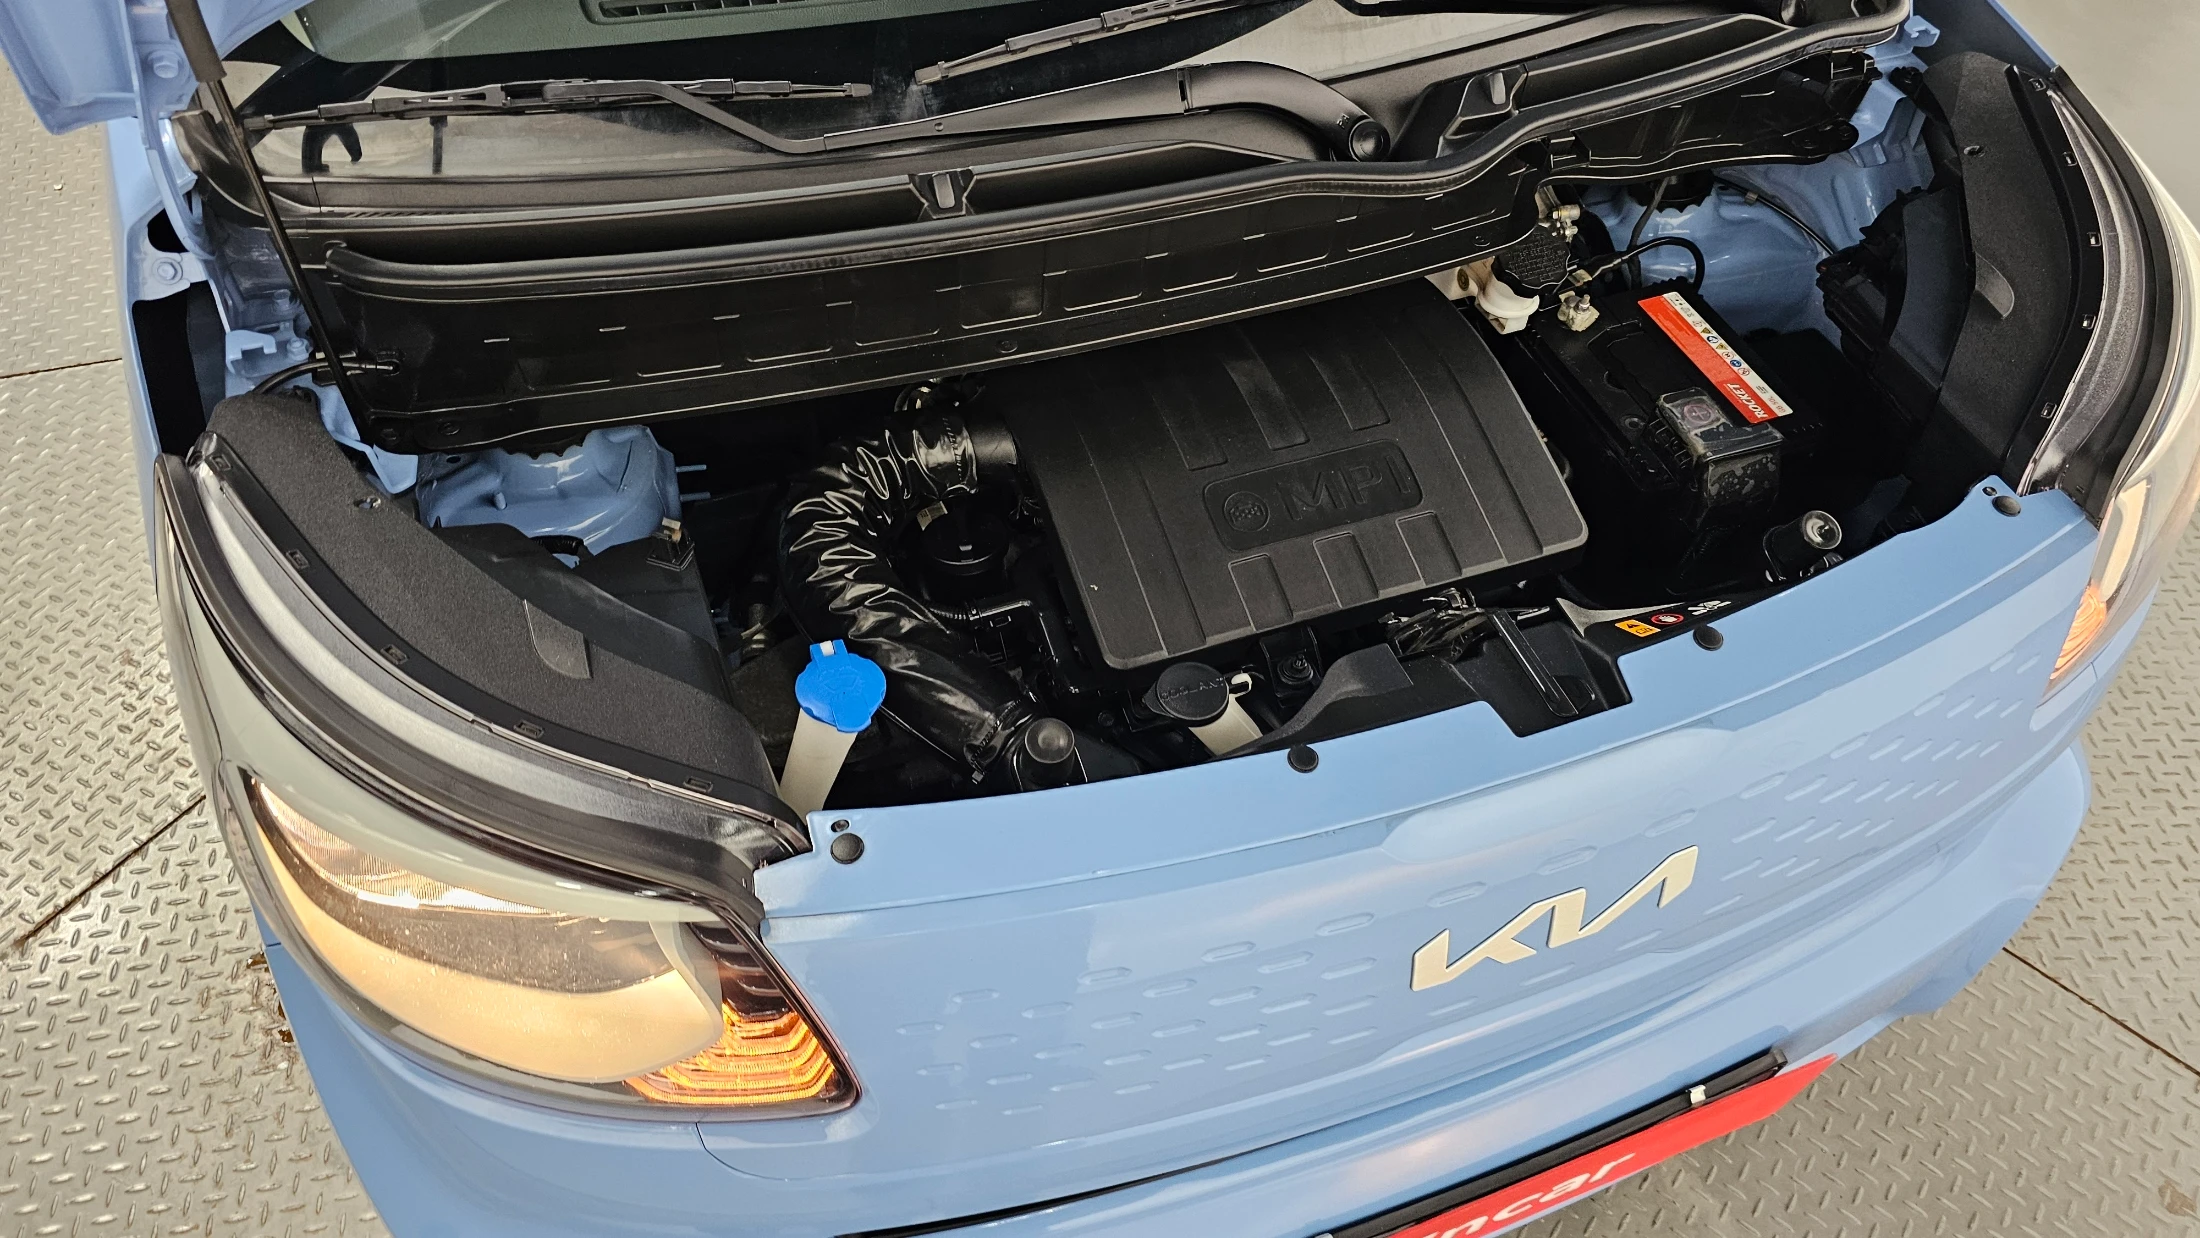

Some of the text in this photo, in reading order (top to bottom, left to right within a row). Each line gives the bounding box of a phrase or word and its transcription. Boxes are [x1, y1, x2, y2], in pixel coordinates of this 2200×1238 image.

[1726, 383, 1769, 418] ROCKET
[1275, 455, 1411, 521] MPI
[1409, 844, 1698, 992] KIA
[1421, 1152, 1637, 1238] ncar
